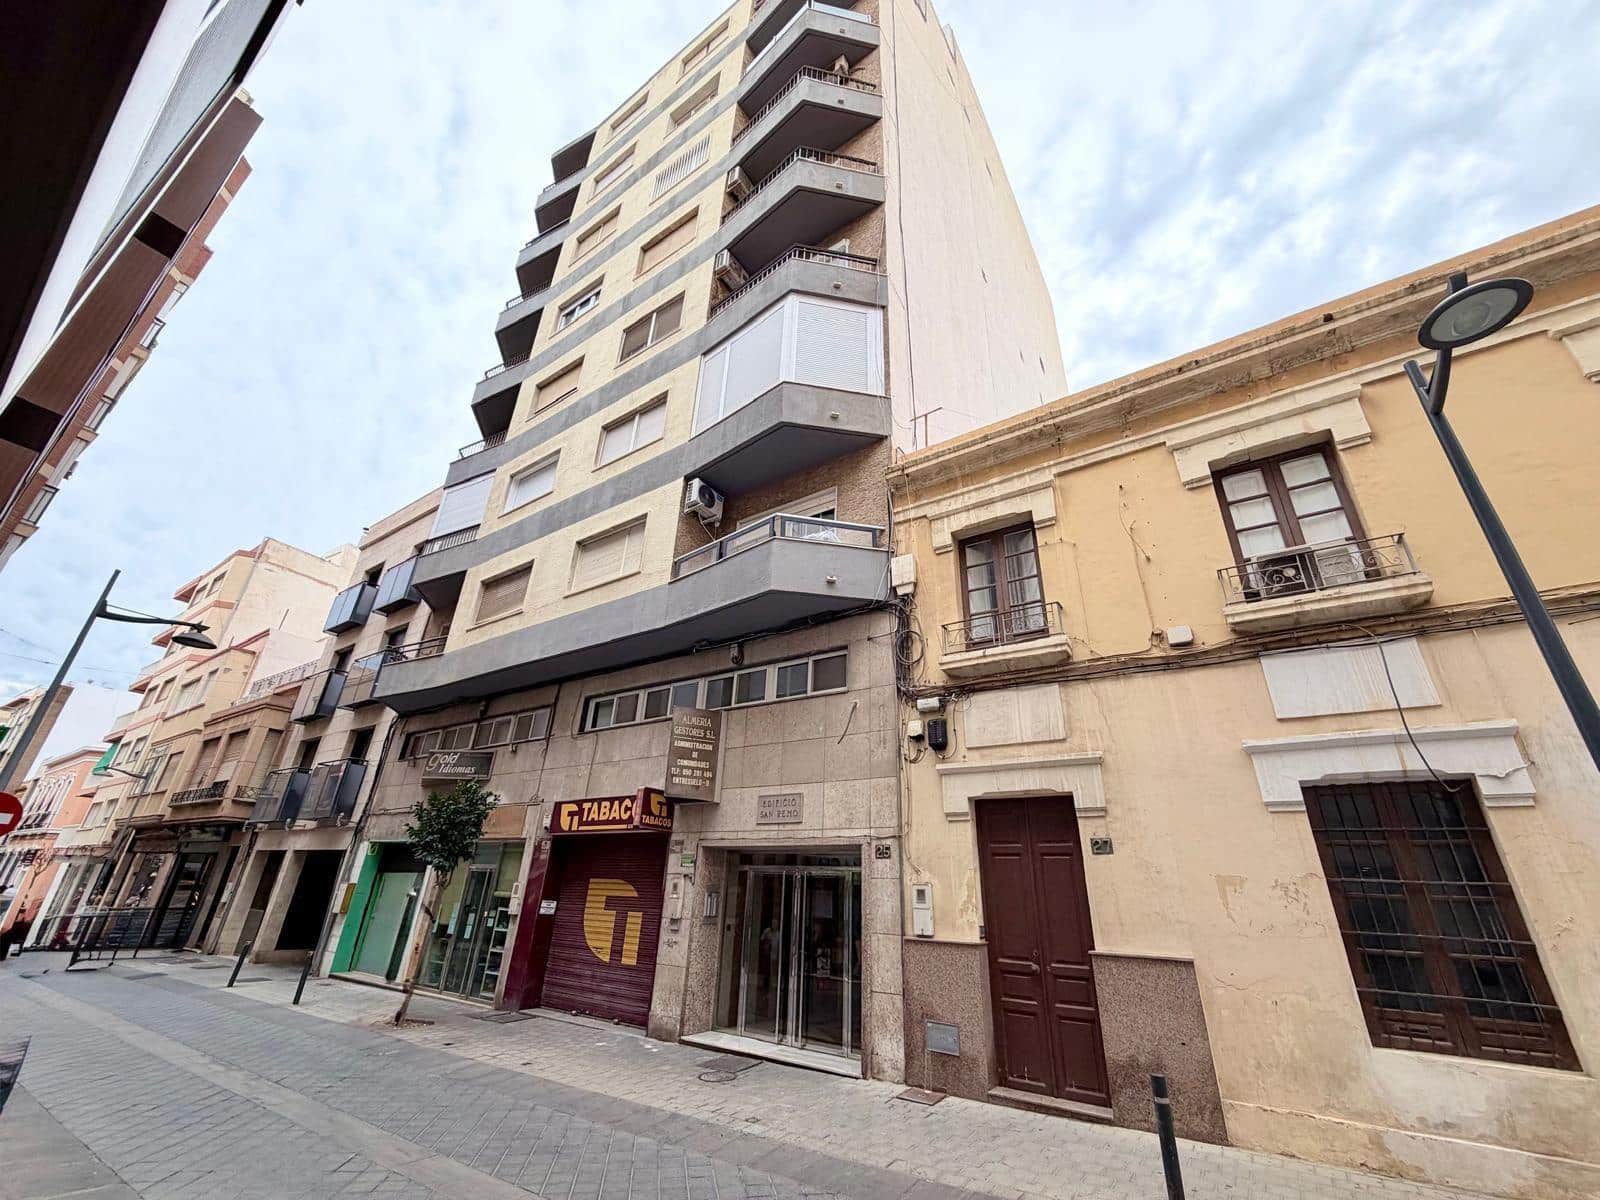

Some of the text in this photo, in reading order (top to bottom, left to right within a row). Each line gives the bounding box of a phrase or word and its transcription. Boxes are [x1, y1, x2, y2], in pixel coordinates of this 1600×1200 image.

[674, 726, 704, 737] GESTORES
[692, 751, 698, 759] DE
[439, 764, 477, 774] Idiomas
[677, 759, 710, 769] COMUNIDADES
[763, 799, 797, 808] EDIFICIO
[760, 808, 799, 818] SAN REMO
[642, 814, 672, 828] TABACOS
[1092, 839, 1111, 853] 27
[876, 845, 890, 858] 25
